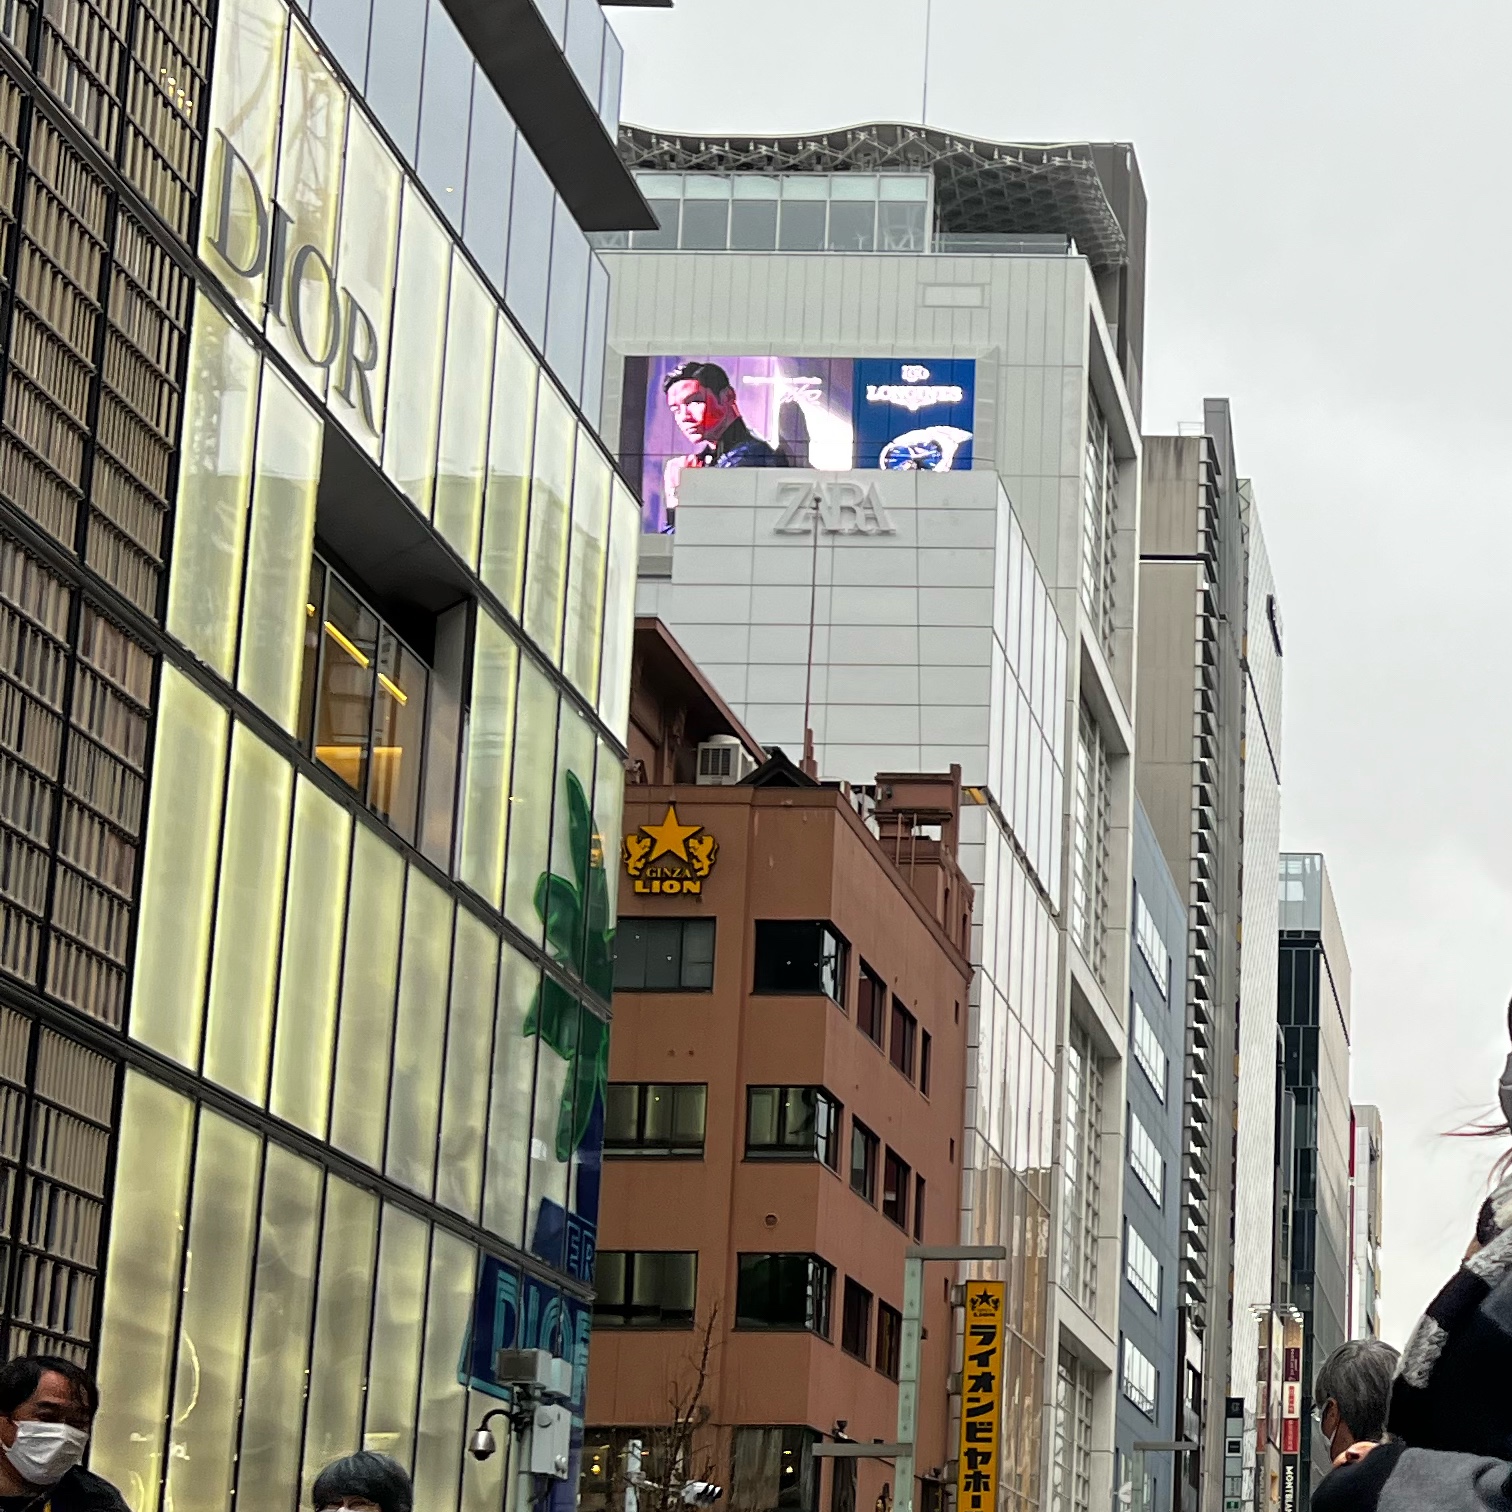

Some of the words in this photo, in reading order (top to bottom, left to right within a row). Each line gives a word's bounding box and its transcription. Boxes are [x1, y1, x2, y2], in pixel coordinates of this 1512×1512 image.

[207, 128, 379, 437] DIOR
[773, 481, 896, 535] ZARA
[634, 880, 701, 893] LION
[646, 867, 691, 878] GINZA
